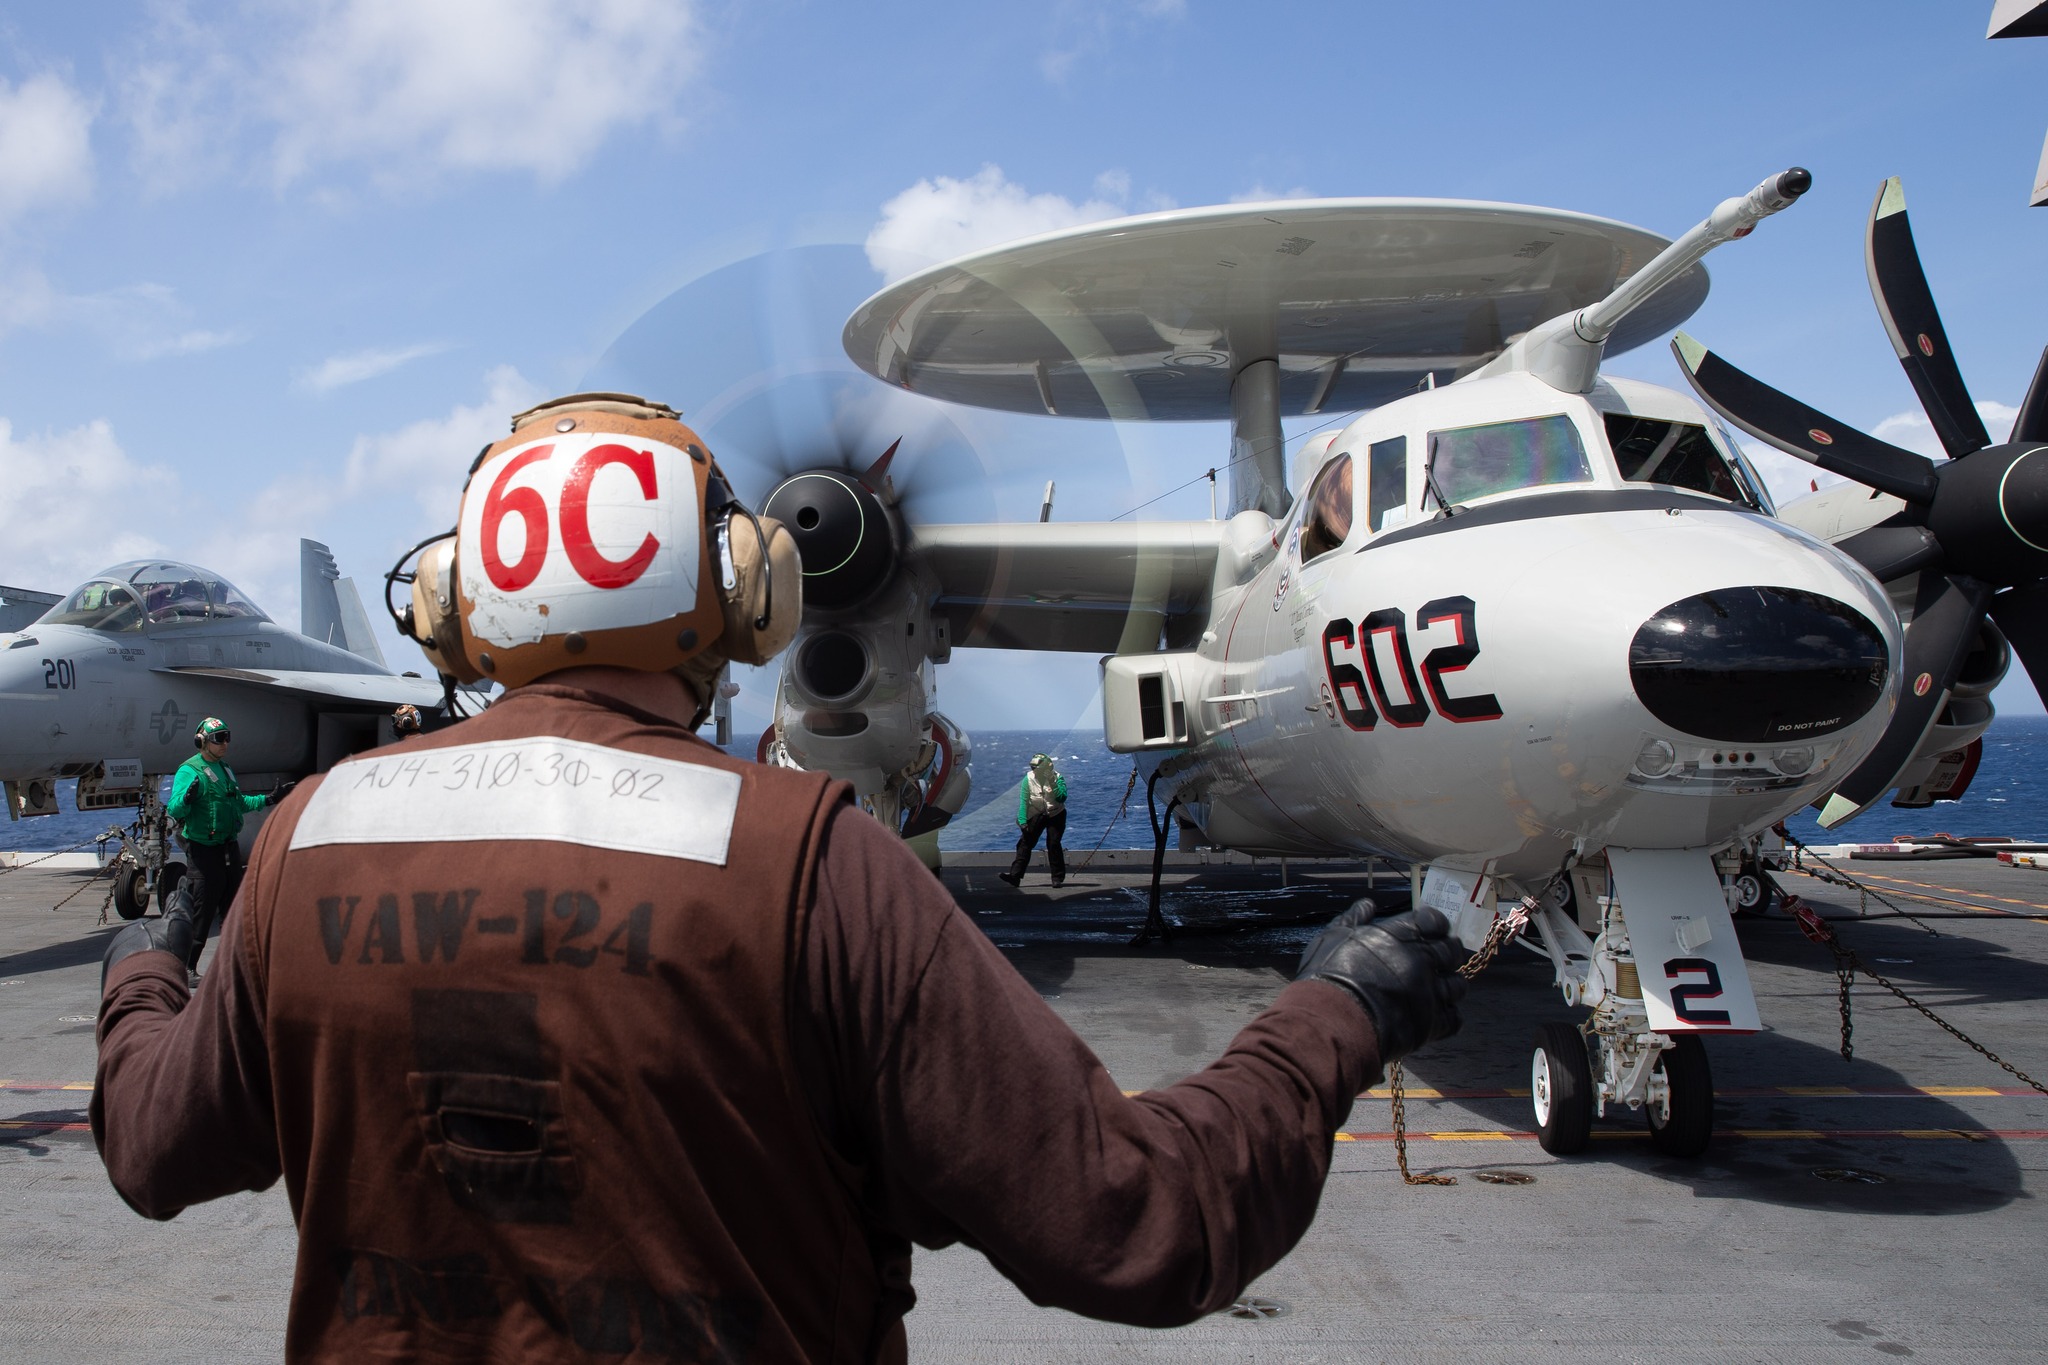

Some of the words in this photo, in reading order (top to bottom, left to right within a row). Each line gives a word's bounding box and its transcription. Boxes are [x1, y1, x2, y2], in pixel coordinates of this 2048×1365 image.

[480, 443, 661, 592] 6C
[42, 659, 75, 690] 201
[1321, 595, 1504, 731] 602
[1793, 722, 1813, 730] NOT
[1814, 717, 1841, 728] PAINT
[317, 887, 656, 977] VAW-124
[1663, 958, 1731, 1025] 2
